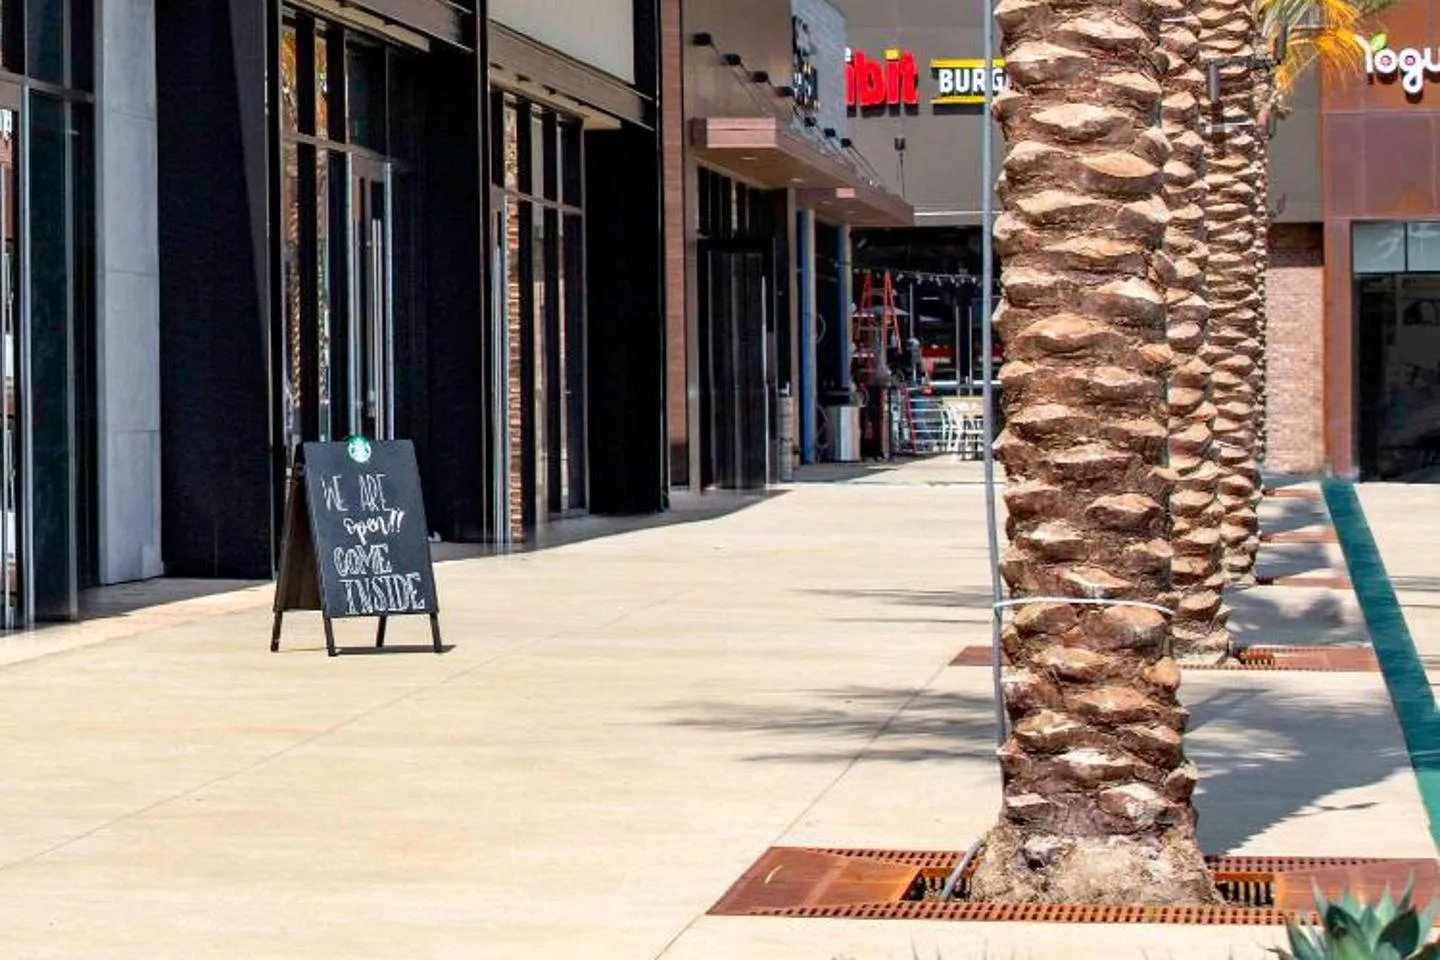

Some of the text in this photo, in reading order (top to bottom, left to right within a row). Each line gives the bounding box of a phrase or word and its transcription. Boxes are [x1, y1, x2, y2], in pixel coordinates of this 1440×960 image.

[938, 68, 1007, 93] BURG
[321, 473, 392, 512] WE ARE
[333, 544, 392, 577] COME
[338, 571, 425, 615] INSIDE
